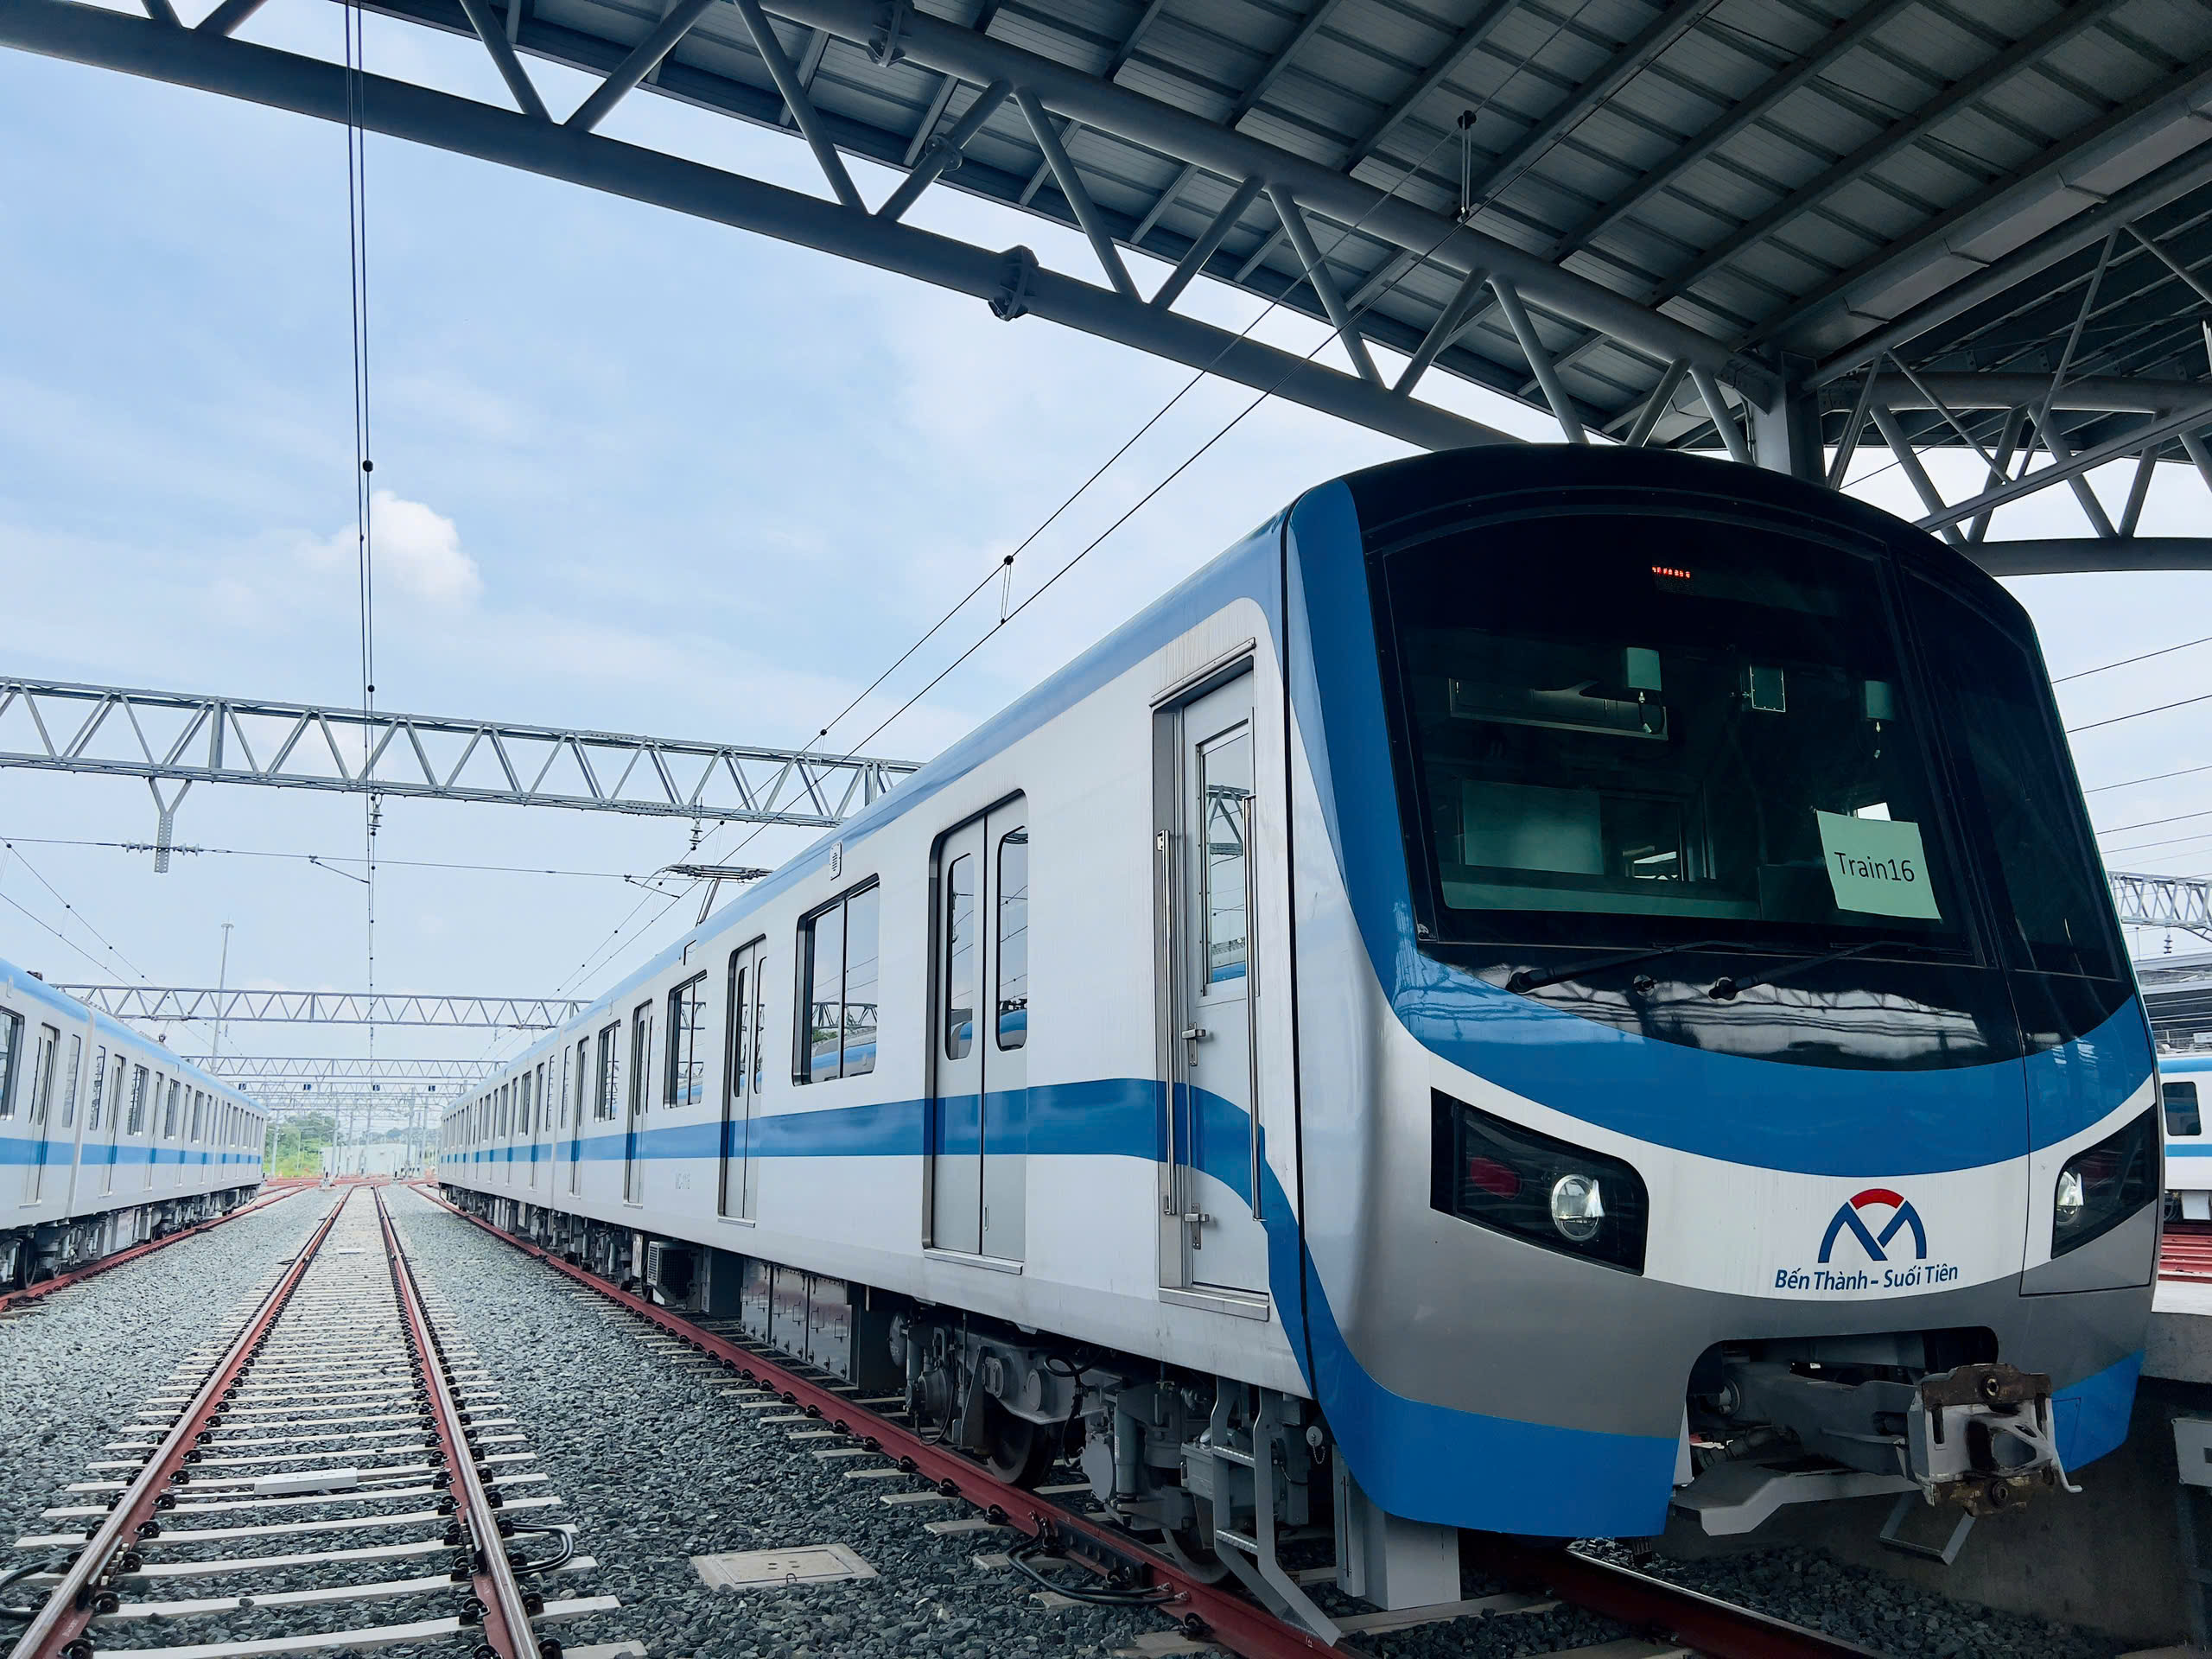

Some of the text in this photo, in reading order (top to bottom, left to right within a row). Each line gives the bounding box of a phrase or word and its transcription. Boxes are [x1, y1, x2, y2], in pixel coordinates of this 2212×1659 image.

[1834, 851, 1915, 882] Train16
[1775, 1268, 1809, 1290] Bến
[1814, 1270, 1867, 1290] Thành
[1884, 1265, 1922, 1287] Suối
[1925, 1263, 1958, 1283] Tiên
